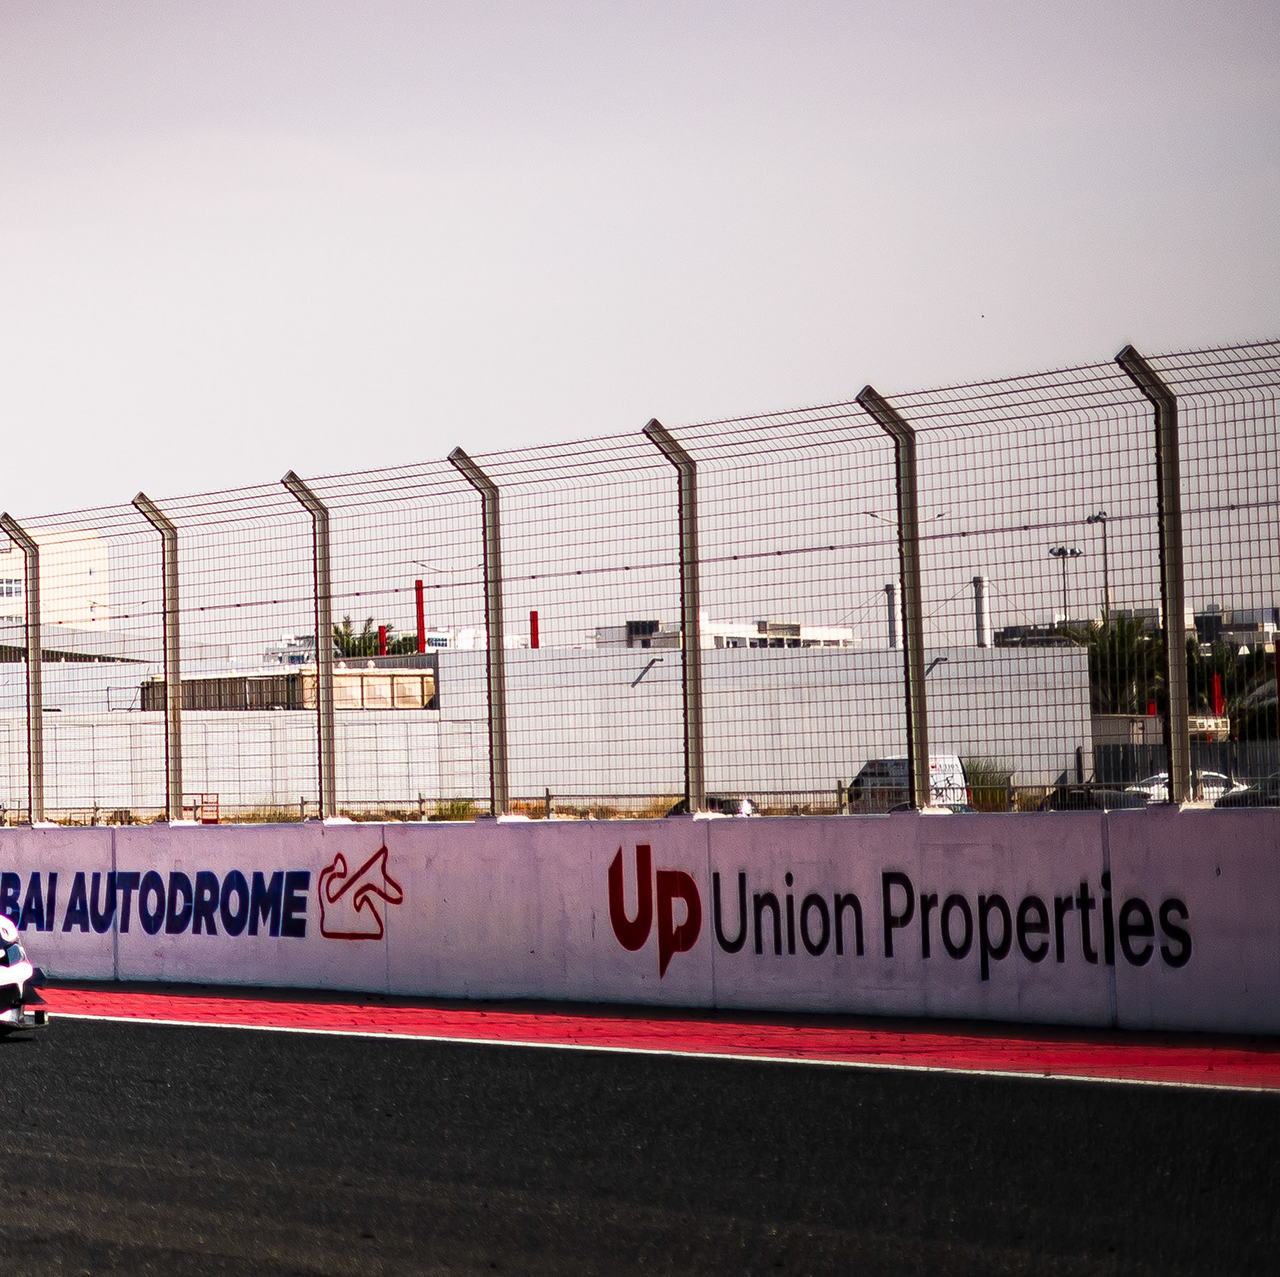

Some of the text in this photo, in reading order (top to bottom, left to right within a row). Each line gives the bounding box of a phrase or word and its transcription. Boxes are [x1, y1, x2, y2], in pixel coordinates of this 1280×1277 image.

[62, 868, 311, 938] AUTODROME
[608, 844, 702, 980] Up
[713, 871, 1193, 982] Union Properties
